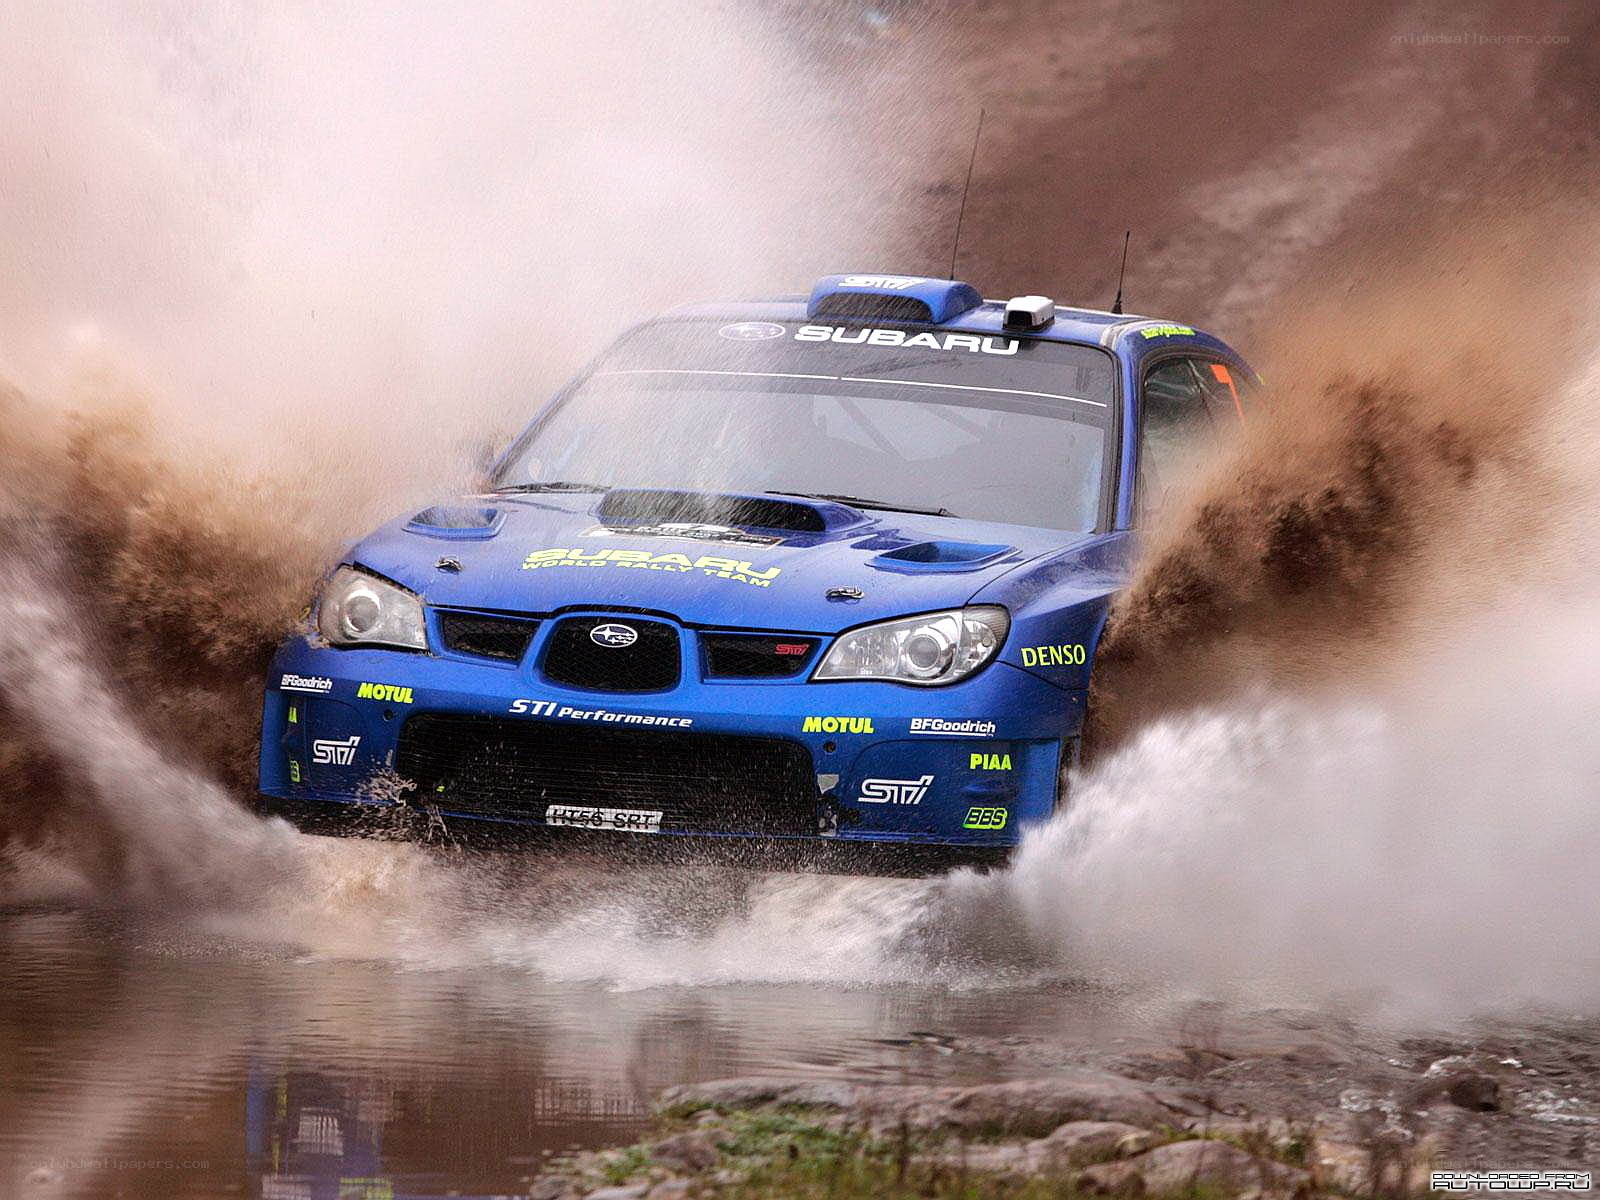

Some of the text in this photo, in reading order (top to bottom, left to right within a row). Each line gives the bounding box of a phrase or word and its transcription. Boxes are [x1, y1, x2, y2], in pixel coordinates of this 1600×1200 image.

[795, 325, 1019, 356] SUBARU
[521, 559, 772, 588] WORLD RALLY TEAM
[525, 548, 782, 580] SUBARU
[1021, 644, 1086, 667] DENSO
[280, 674, 333, 690] BFGoodrich
[357, 682, 414, 704] MOTUL
[508, 699, 694, 728] STI Performance
[802, 716, 875, 735] MOTUL
[910, 717, 996, 734] BFGoodrich
[969, 753, 1012, 771] PIAA
[963, 807, 1008, 829] BBS
